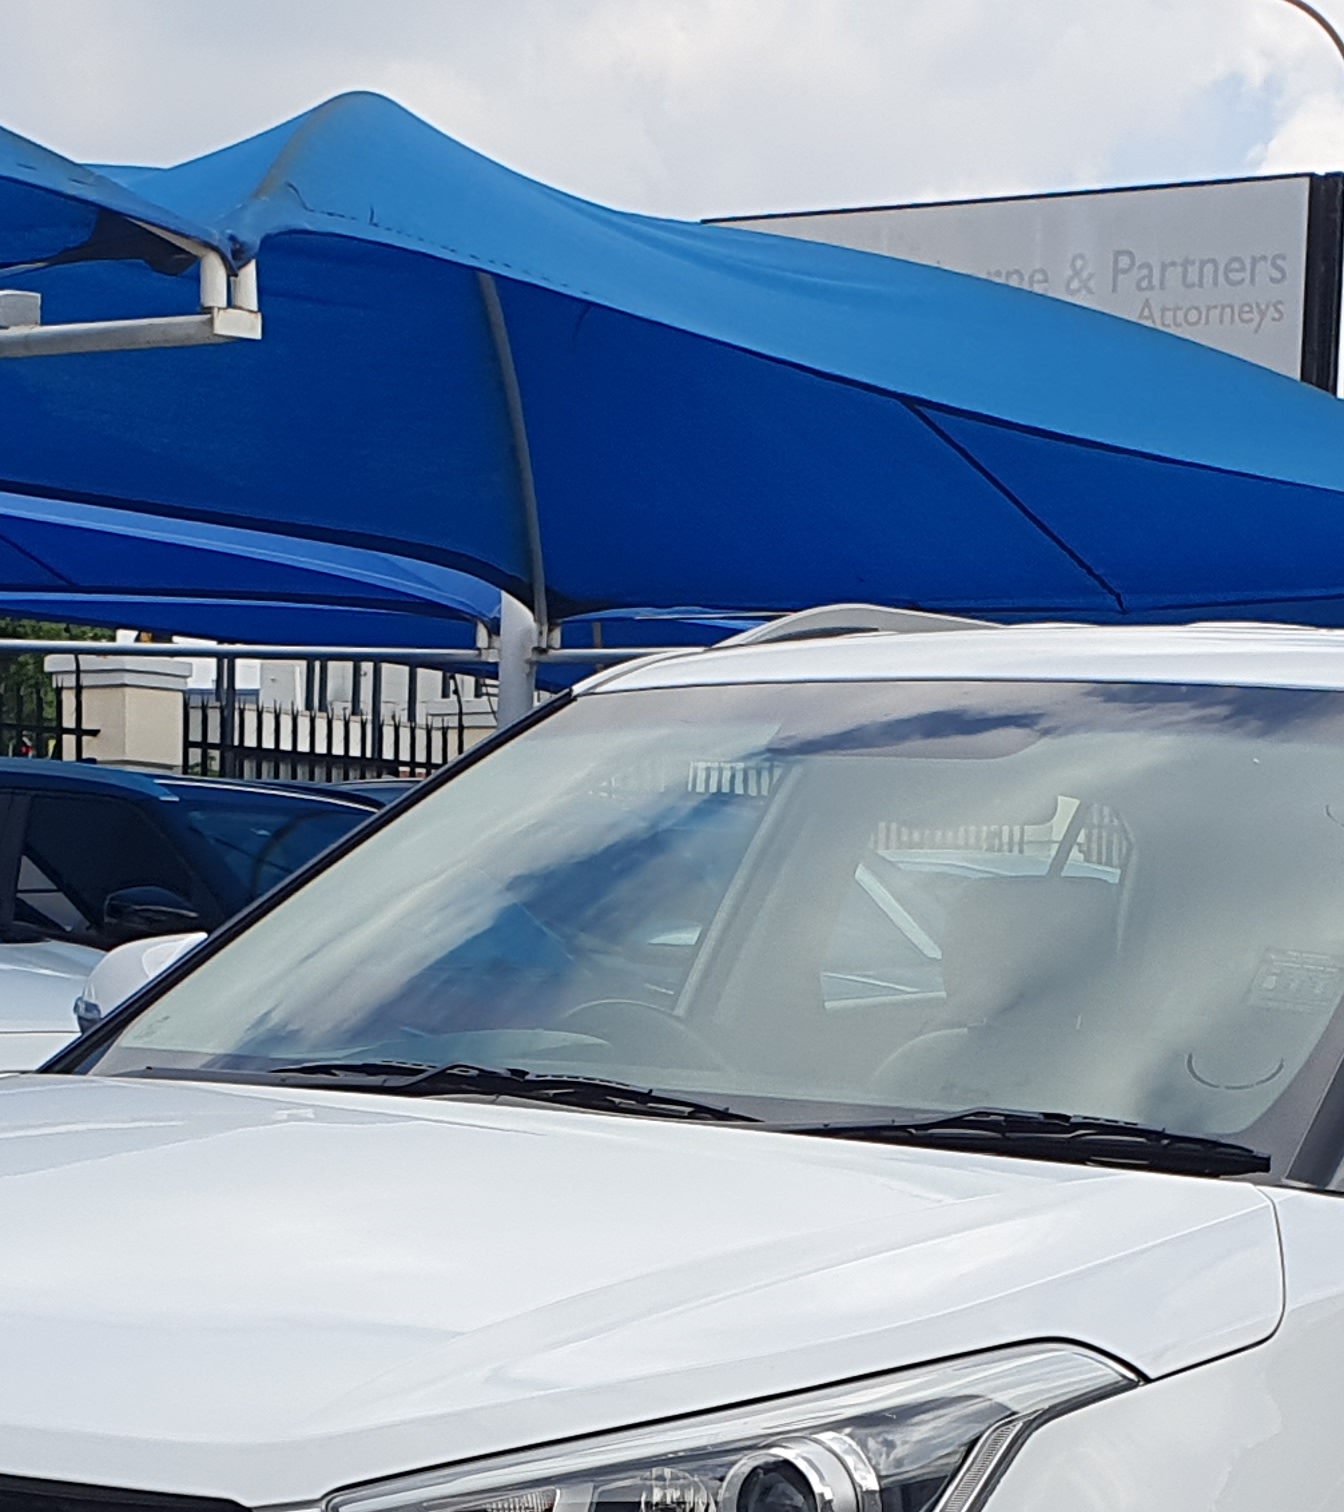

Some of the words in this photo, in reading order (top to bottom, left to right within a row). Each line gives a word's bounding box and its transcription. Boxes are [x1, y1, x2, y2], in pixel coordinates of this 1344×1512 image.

[1064, 252, 1096, 296] &
[1110, 249, 1288, 294] Partners
[1136, 298, 1286, 335] Attorneys
